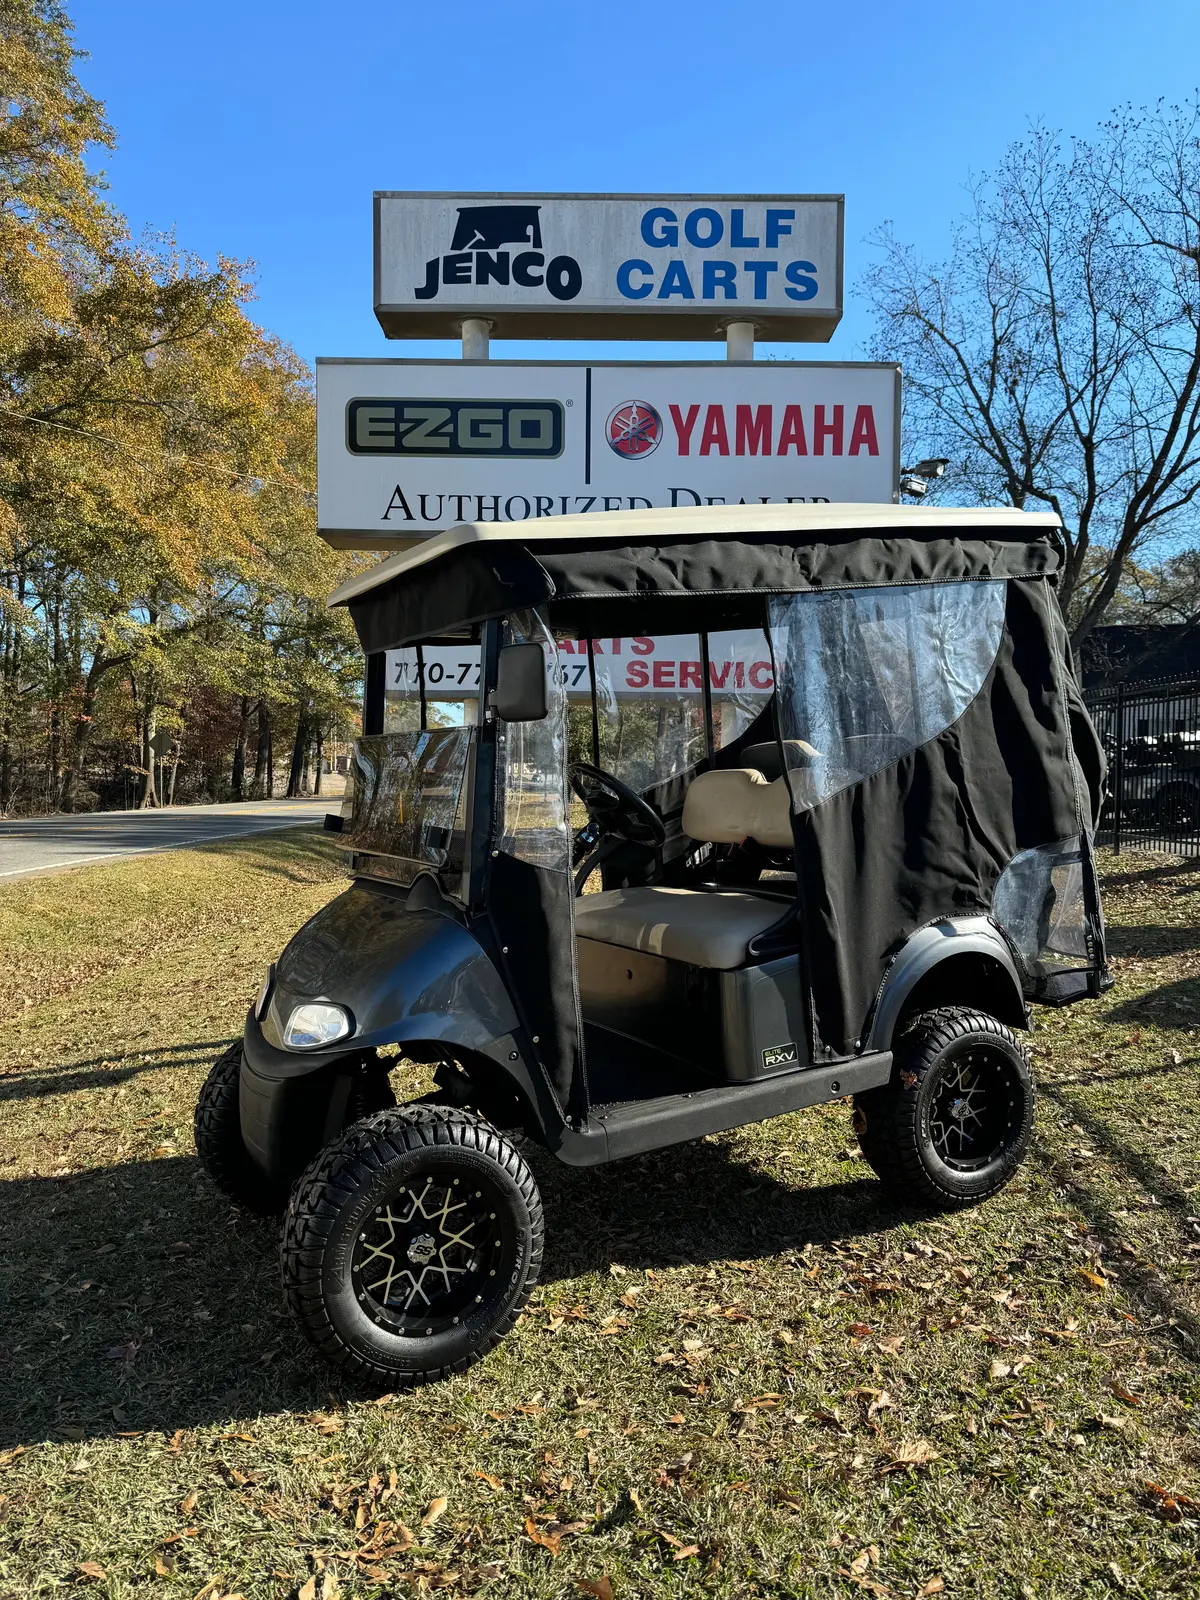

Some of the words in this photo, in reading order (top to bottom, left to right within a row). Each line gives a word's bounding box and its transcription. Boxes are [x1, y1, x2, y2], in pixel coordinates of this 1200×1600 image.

[640, 207, 796, 249] GOLF
[413, 251, 583, 301] JENCO
[616, 258, 819, 301] CARTS
[356, 406, 554, 450] EZGO
[669, 404, 879, 457] YAMAHA
[627, 660, 782, 690] SERVIC
[765, 1051, 795, 1066] RXV
